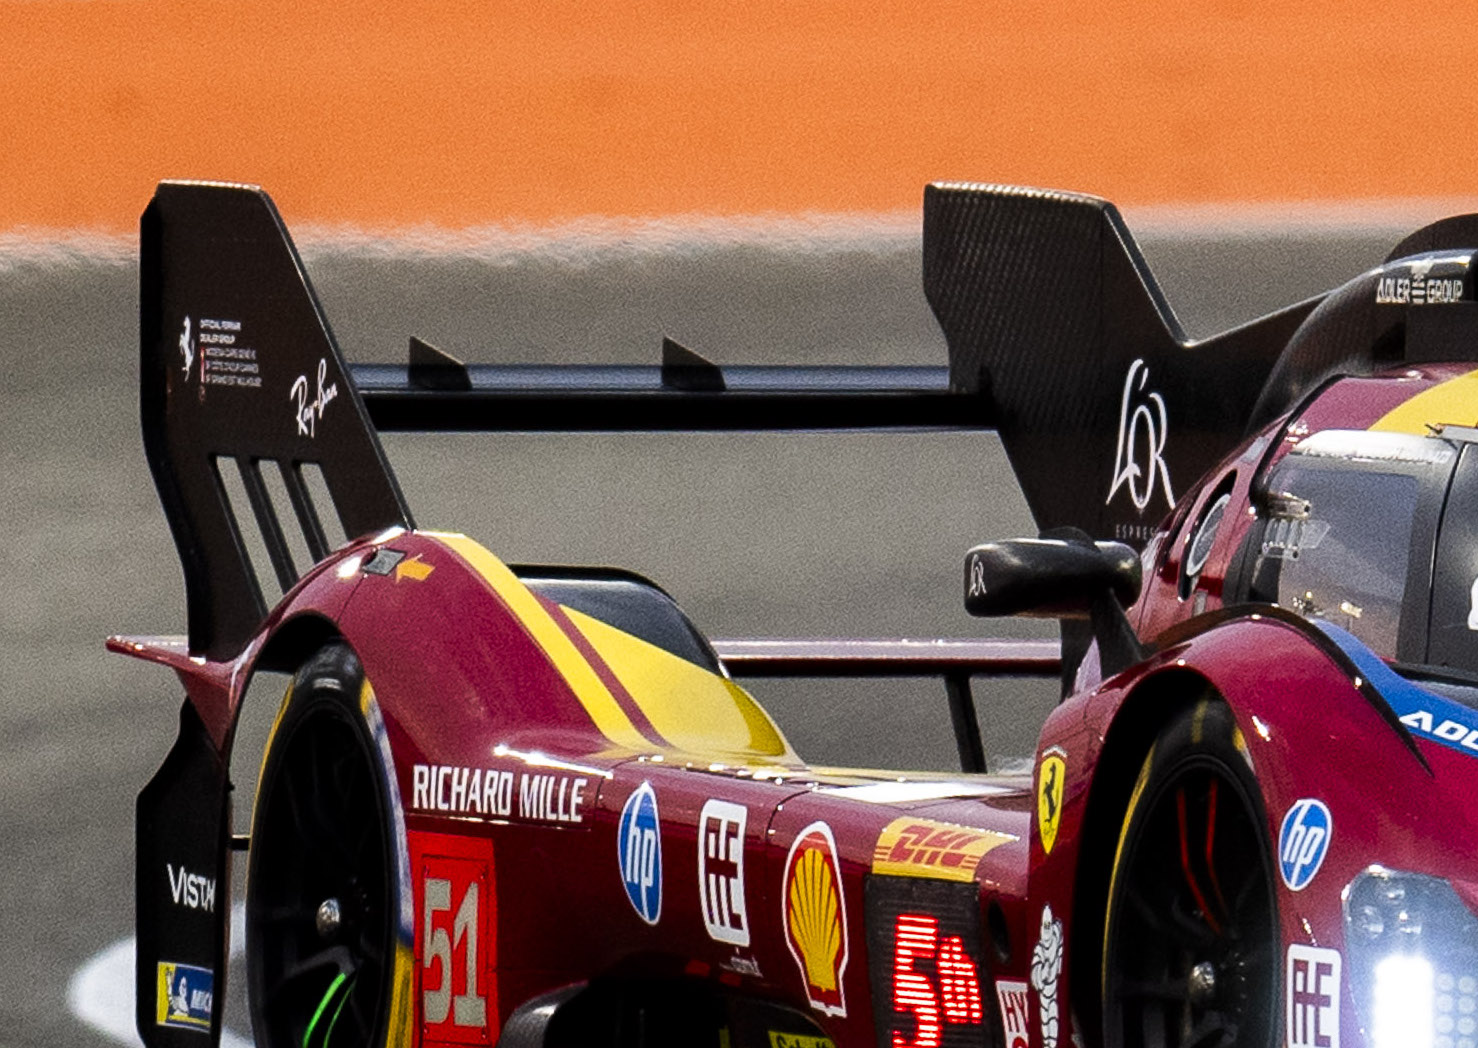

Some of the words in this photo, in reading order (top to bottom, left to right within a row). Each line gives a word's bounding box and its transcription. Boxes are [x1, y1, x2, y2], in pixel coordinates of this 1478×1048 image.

[1376, 278, 1410, 303] ADLER
[1427, 279, 1463, 303] GROUP
[412, 764, 512, 816] RICHARD
[517, 770, 587, 823] MILLE
[625, 798, 657, 908] hp
[888, 825, 985, 867] DHL
[1283, 803, 1325, 887] hp
[423, 876, 486, 1028] 51
